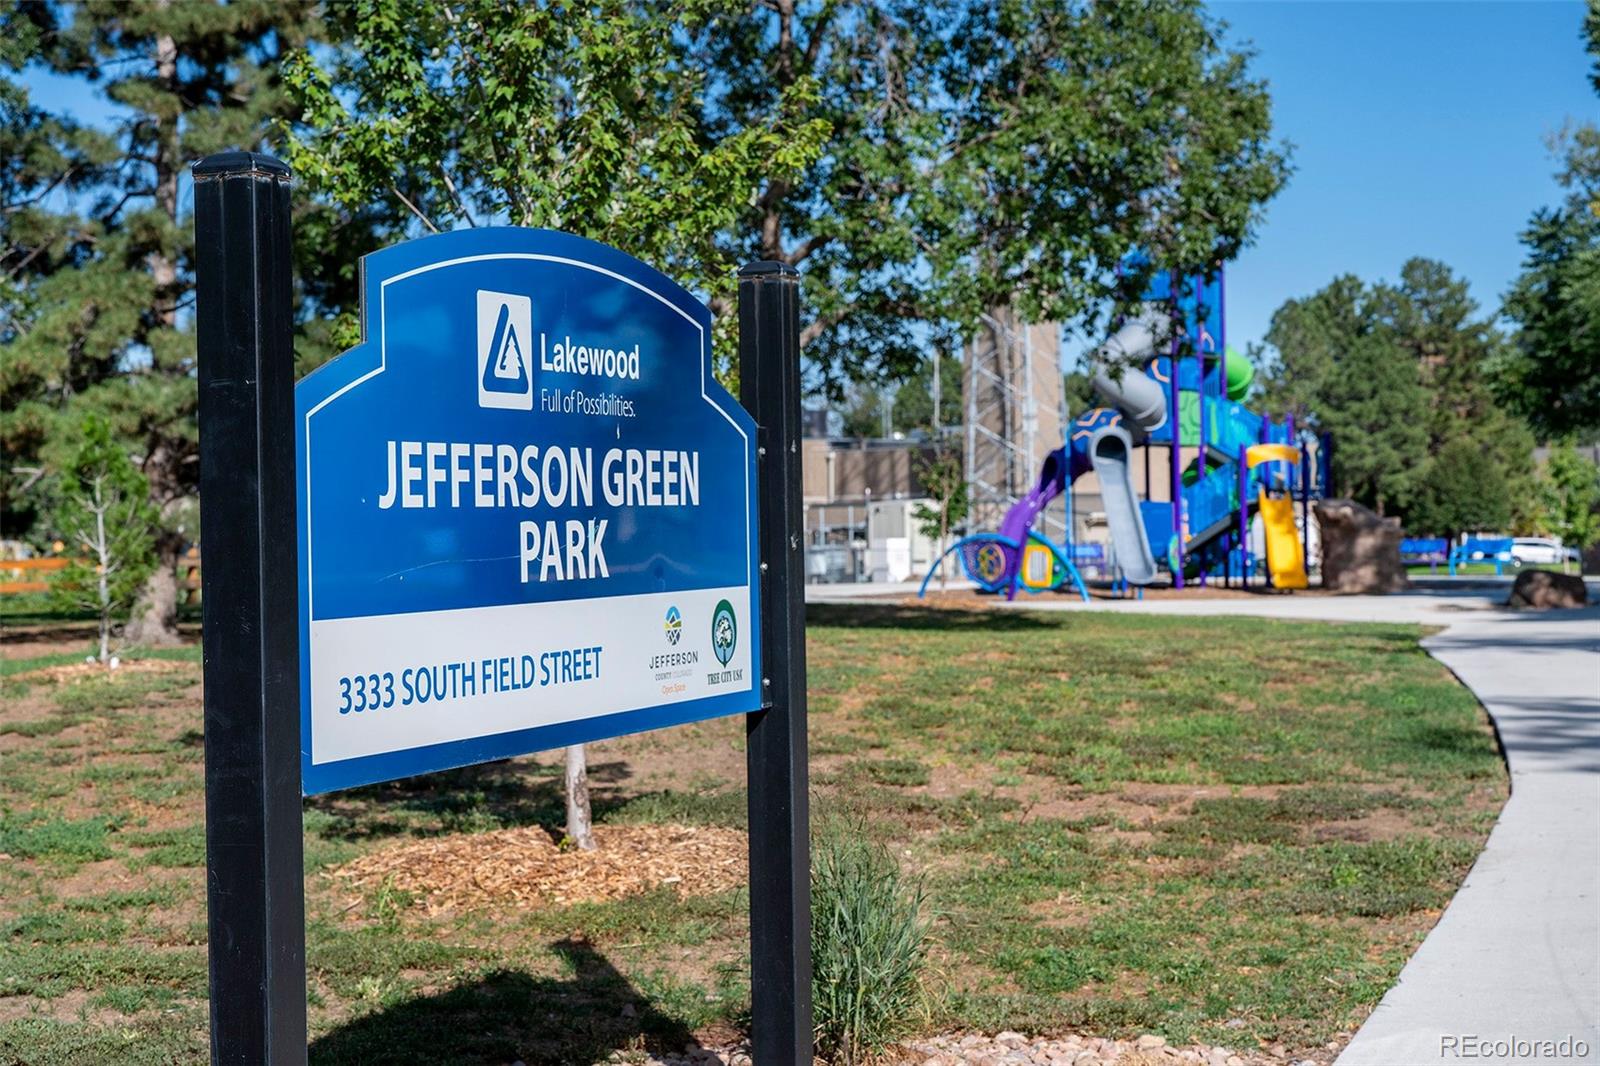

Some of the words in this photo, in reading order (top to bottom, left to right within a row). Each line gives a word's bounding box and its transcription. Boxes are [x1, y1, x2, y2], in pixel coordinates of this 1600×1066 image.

[540, 333, 640, 380] Lakewood
[541, 389, 560, 412] Full
[563, 391, 575, 414] of
[378, 441, 593, 510] JEFFERSON
[602, 448, 699, 507] GREEN
[520, 519, 610, 583] PARK
[339, 673, 394, 714] 3333
[402, 661, 475, 706] SOUTH
[482, 654, 535, 694] FIELD
[540, 646, 602, 687] STREET
[649, 651, 698, 669] JEFFERSON
[707, 672, 720, 685] TREE
[721, 671, 732, 683] CITY
